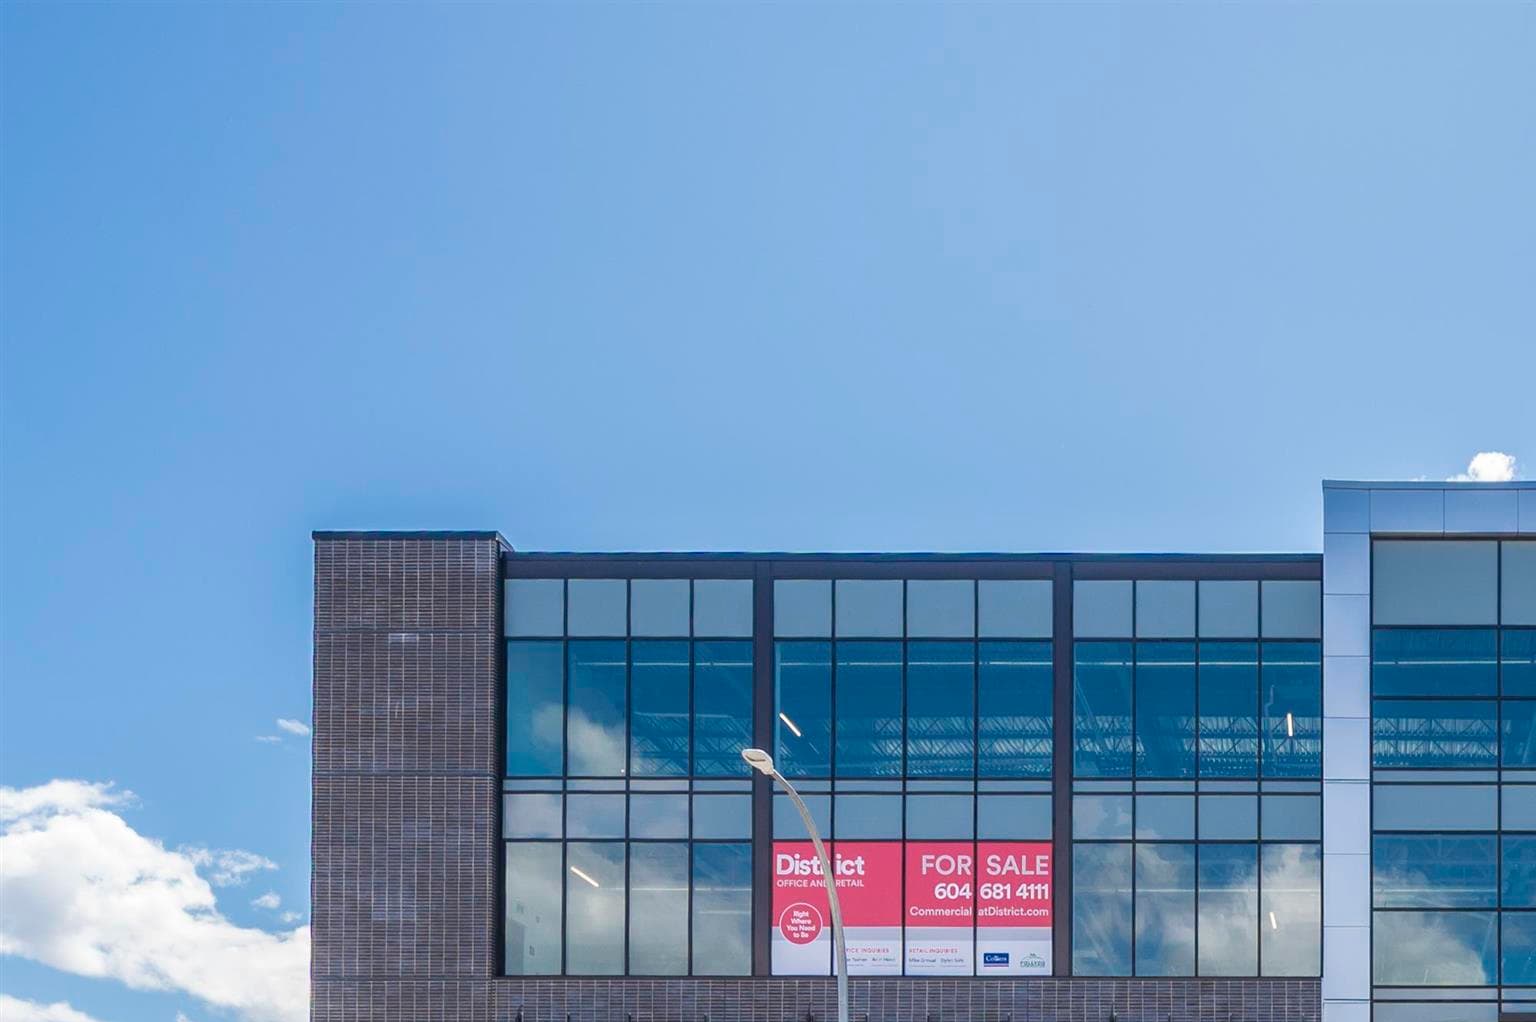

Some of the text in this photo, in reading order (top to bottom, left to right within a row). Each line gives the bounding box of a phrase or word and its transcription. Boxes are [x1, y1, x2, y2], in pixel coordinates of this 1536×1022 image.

[776, 854, 865, 876] Distict
[922, 855, 1049, 875] FOR SALE
[777, 879, 808, 887] OFFICE
[835, 879, 864, 887] RETAIL
[934, 883, 1049, 899] 604 681 4111
